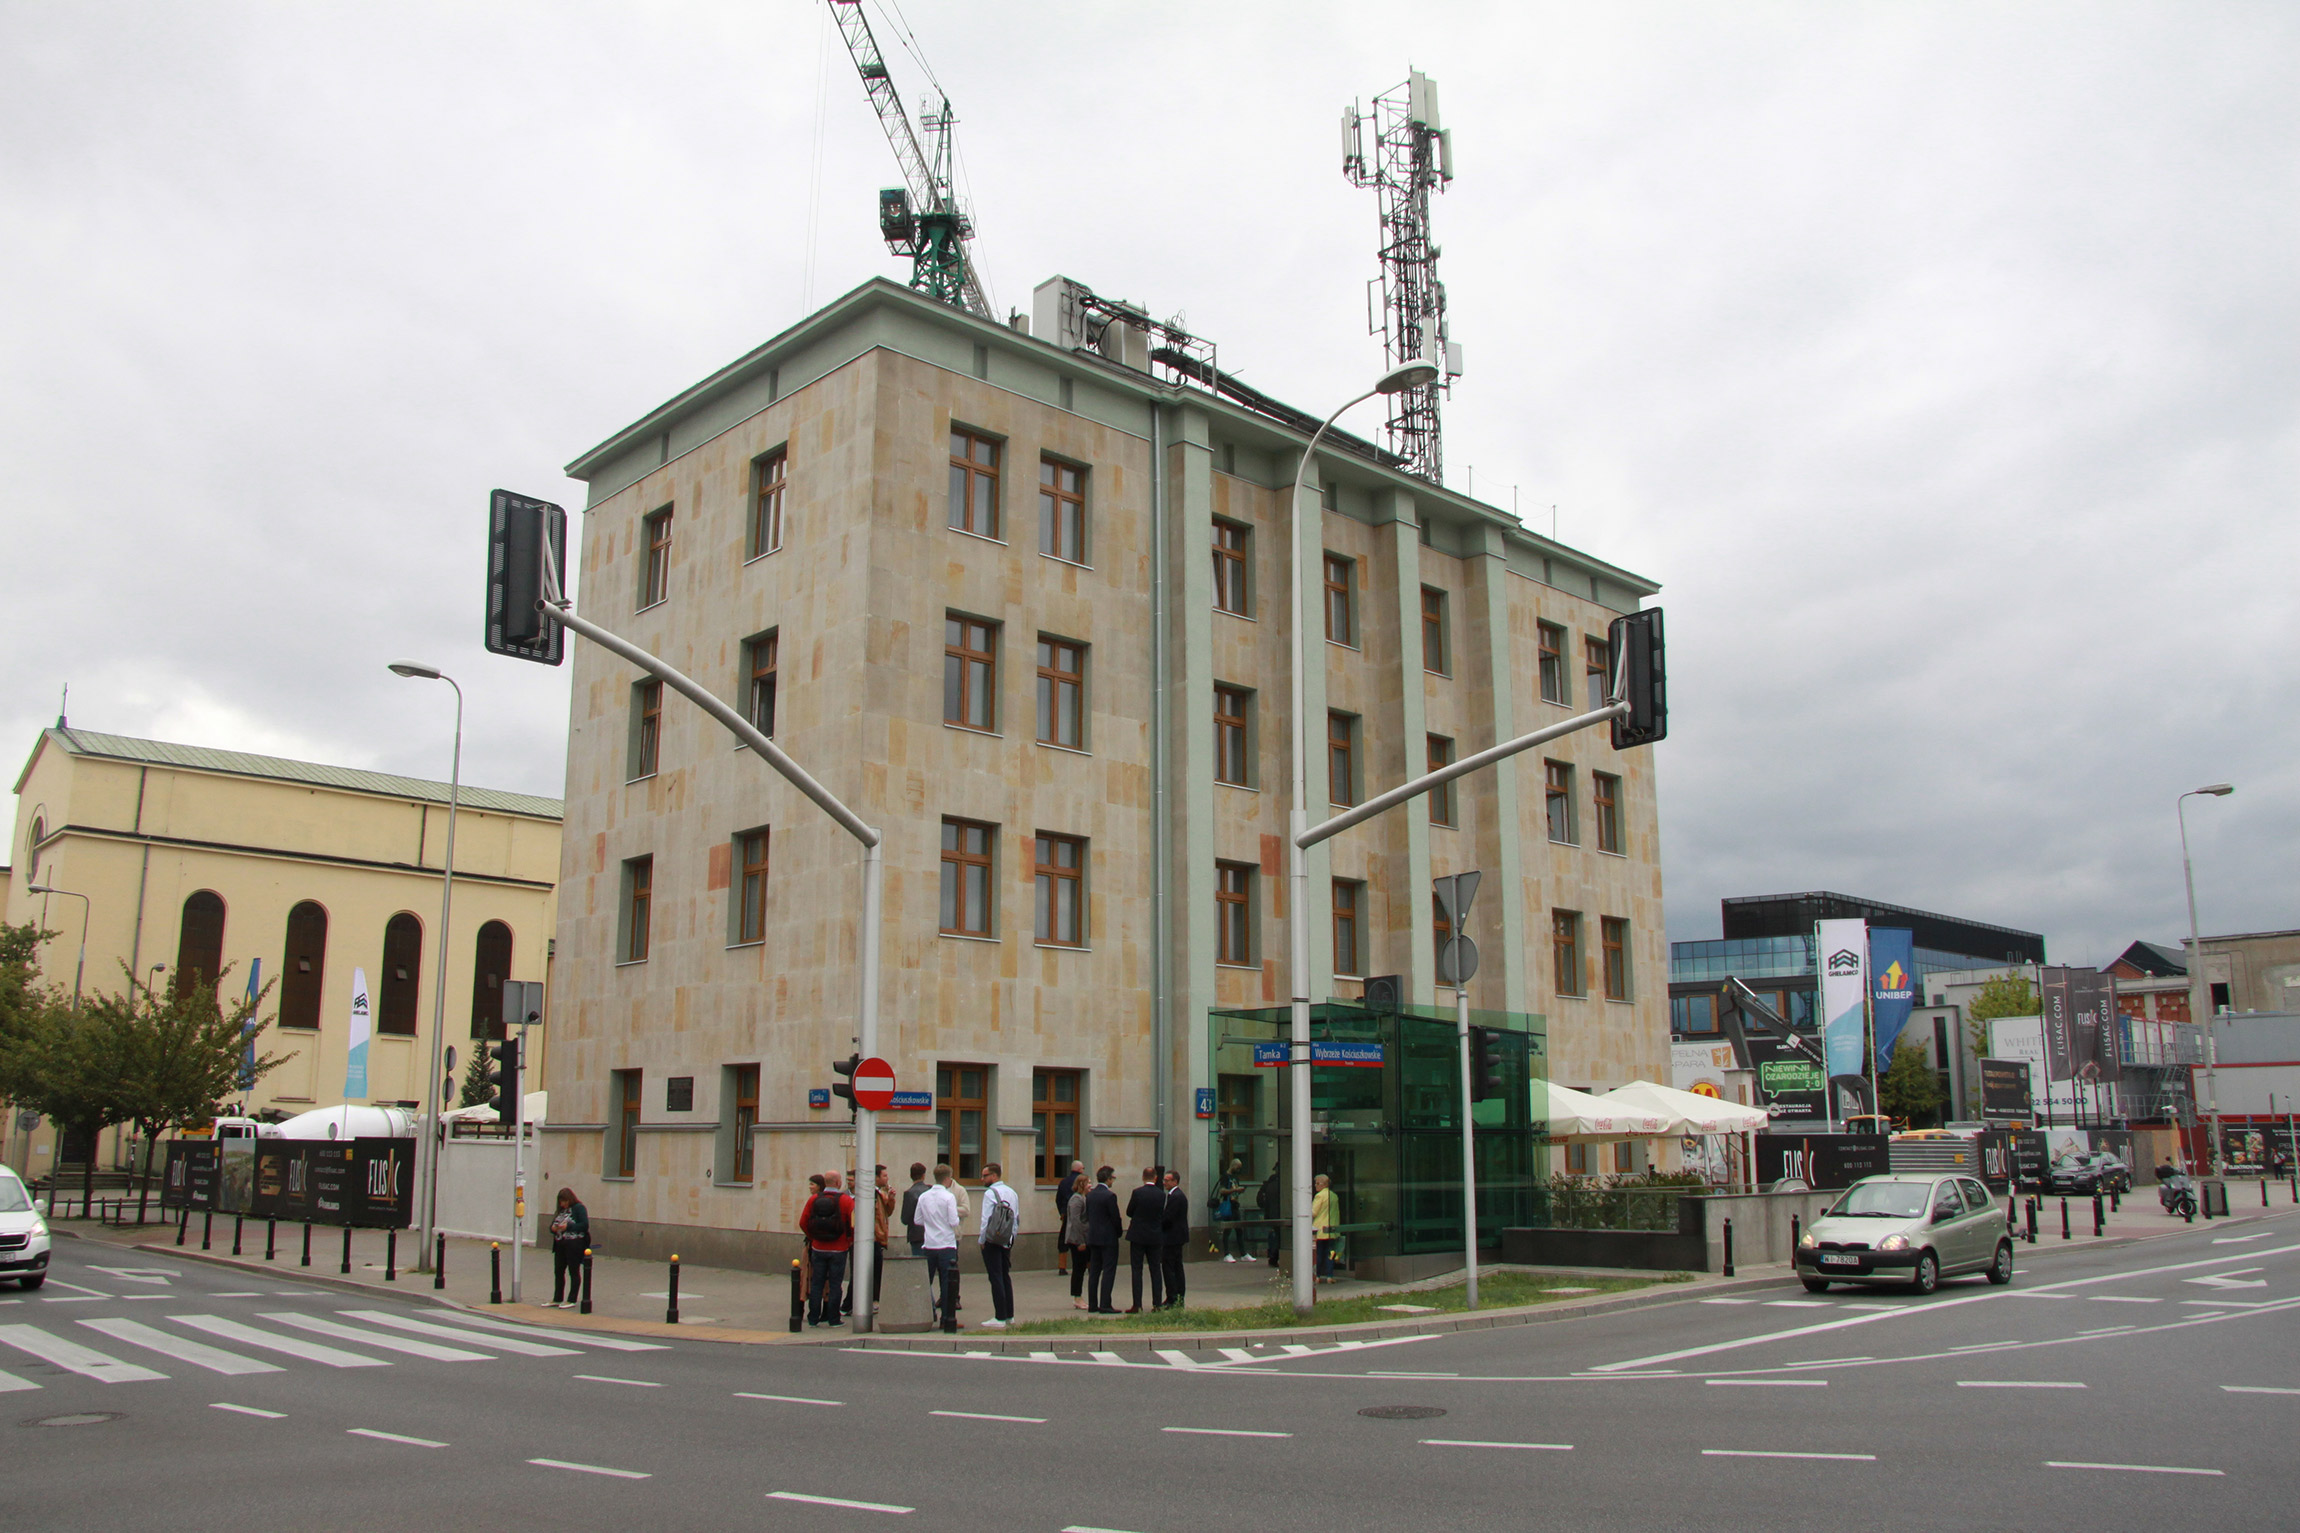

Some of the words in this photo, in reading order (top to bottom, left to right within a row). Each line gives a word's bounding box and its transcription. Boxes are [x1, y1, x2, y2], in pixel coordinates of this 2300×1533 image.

[1828, 969, 1858, 977] GHELAMCO
[1875, 990, 1912, 999] UNIBEP
[2053, 995, 2065, 1056] FLISAC.COM
[2100, 1000, 2112, 1057] FLISAC.COM
[1258, 1048, 1281, 1060] Tamka
[1314, 1048, 1341, 1060] Wybrzeże
[1341, 1049, 1381, 1060] Kościuszkowskie
[1765, 1064, 1810, 1073] NIEWINNI
[1765, 1072, 1820, 1080] CZARODZIEJE
